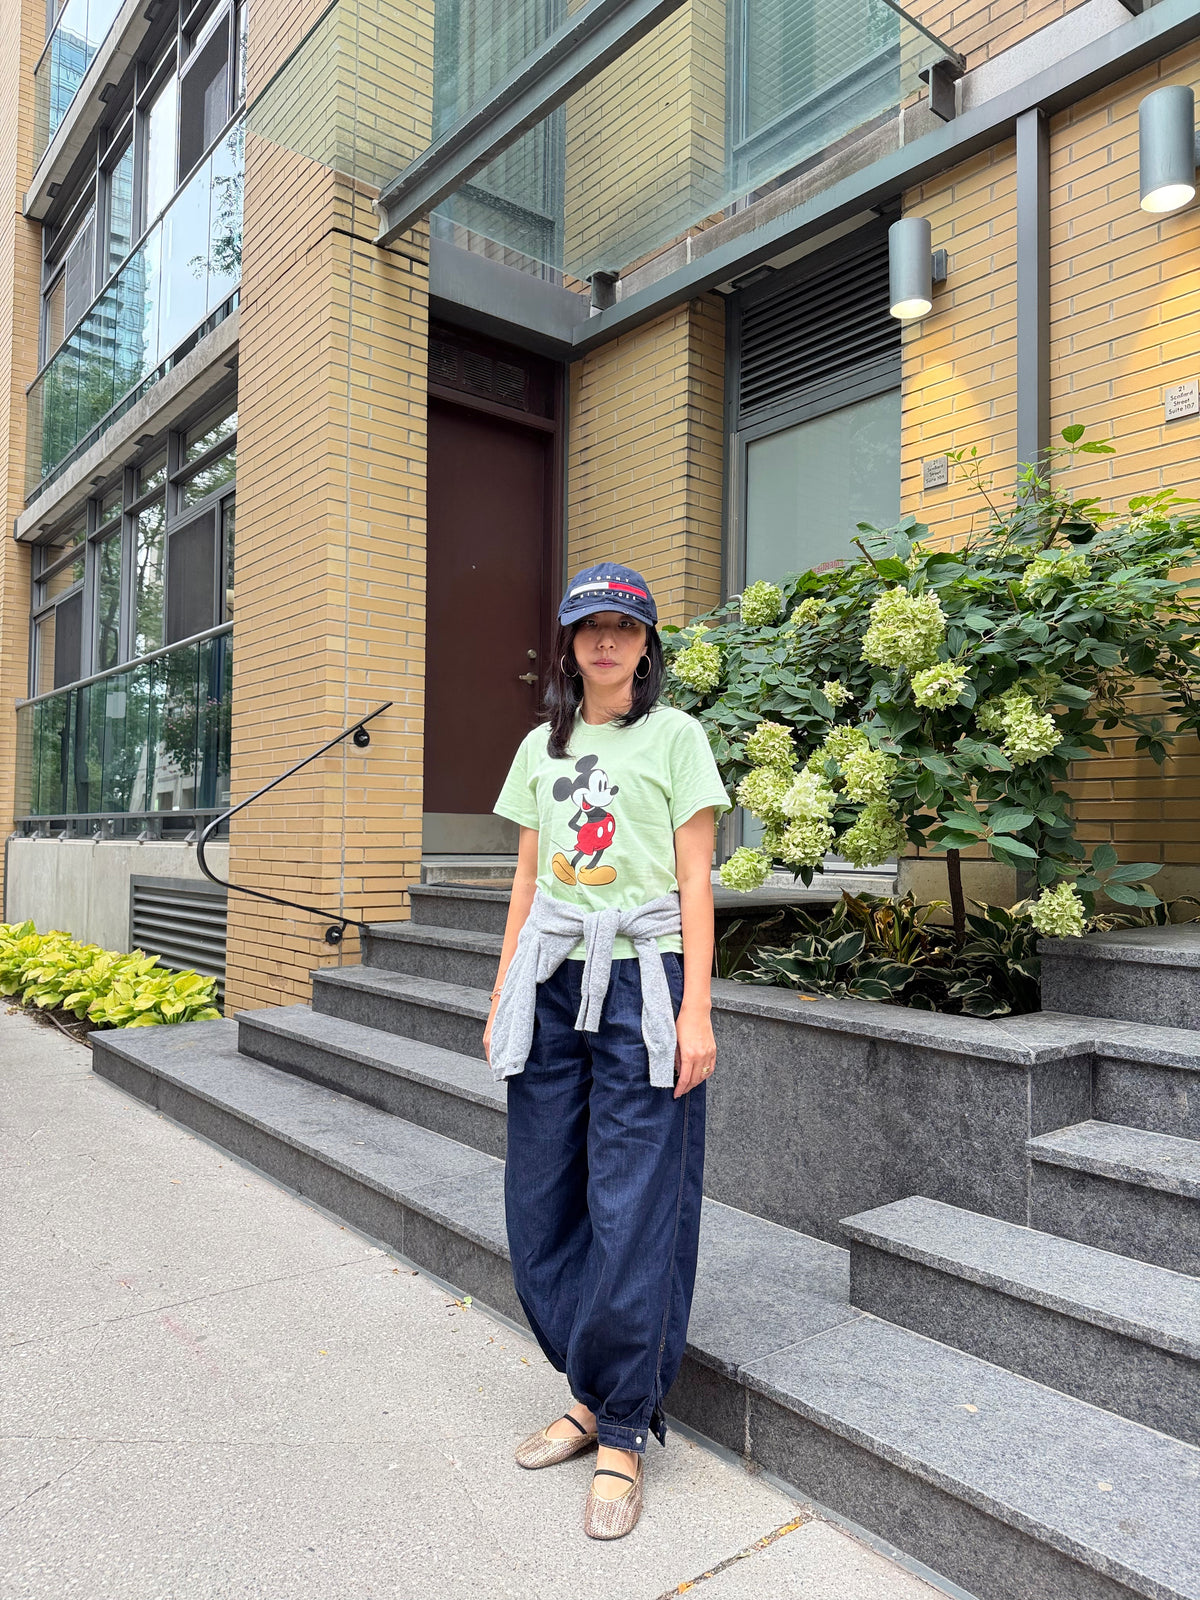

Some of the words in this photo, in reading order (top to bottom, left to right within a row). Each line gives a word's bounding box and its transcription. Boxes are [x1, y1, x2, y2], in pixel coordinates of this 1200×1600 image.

[1173, 398, 1190, 407] Street
[1168, 407, 1183, 415] Suite
[1184, 402, 1195, 410] 107
[588, 575, 629, 583] TOMMY
